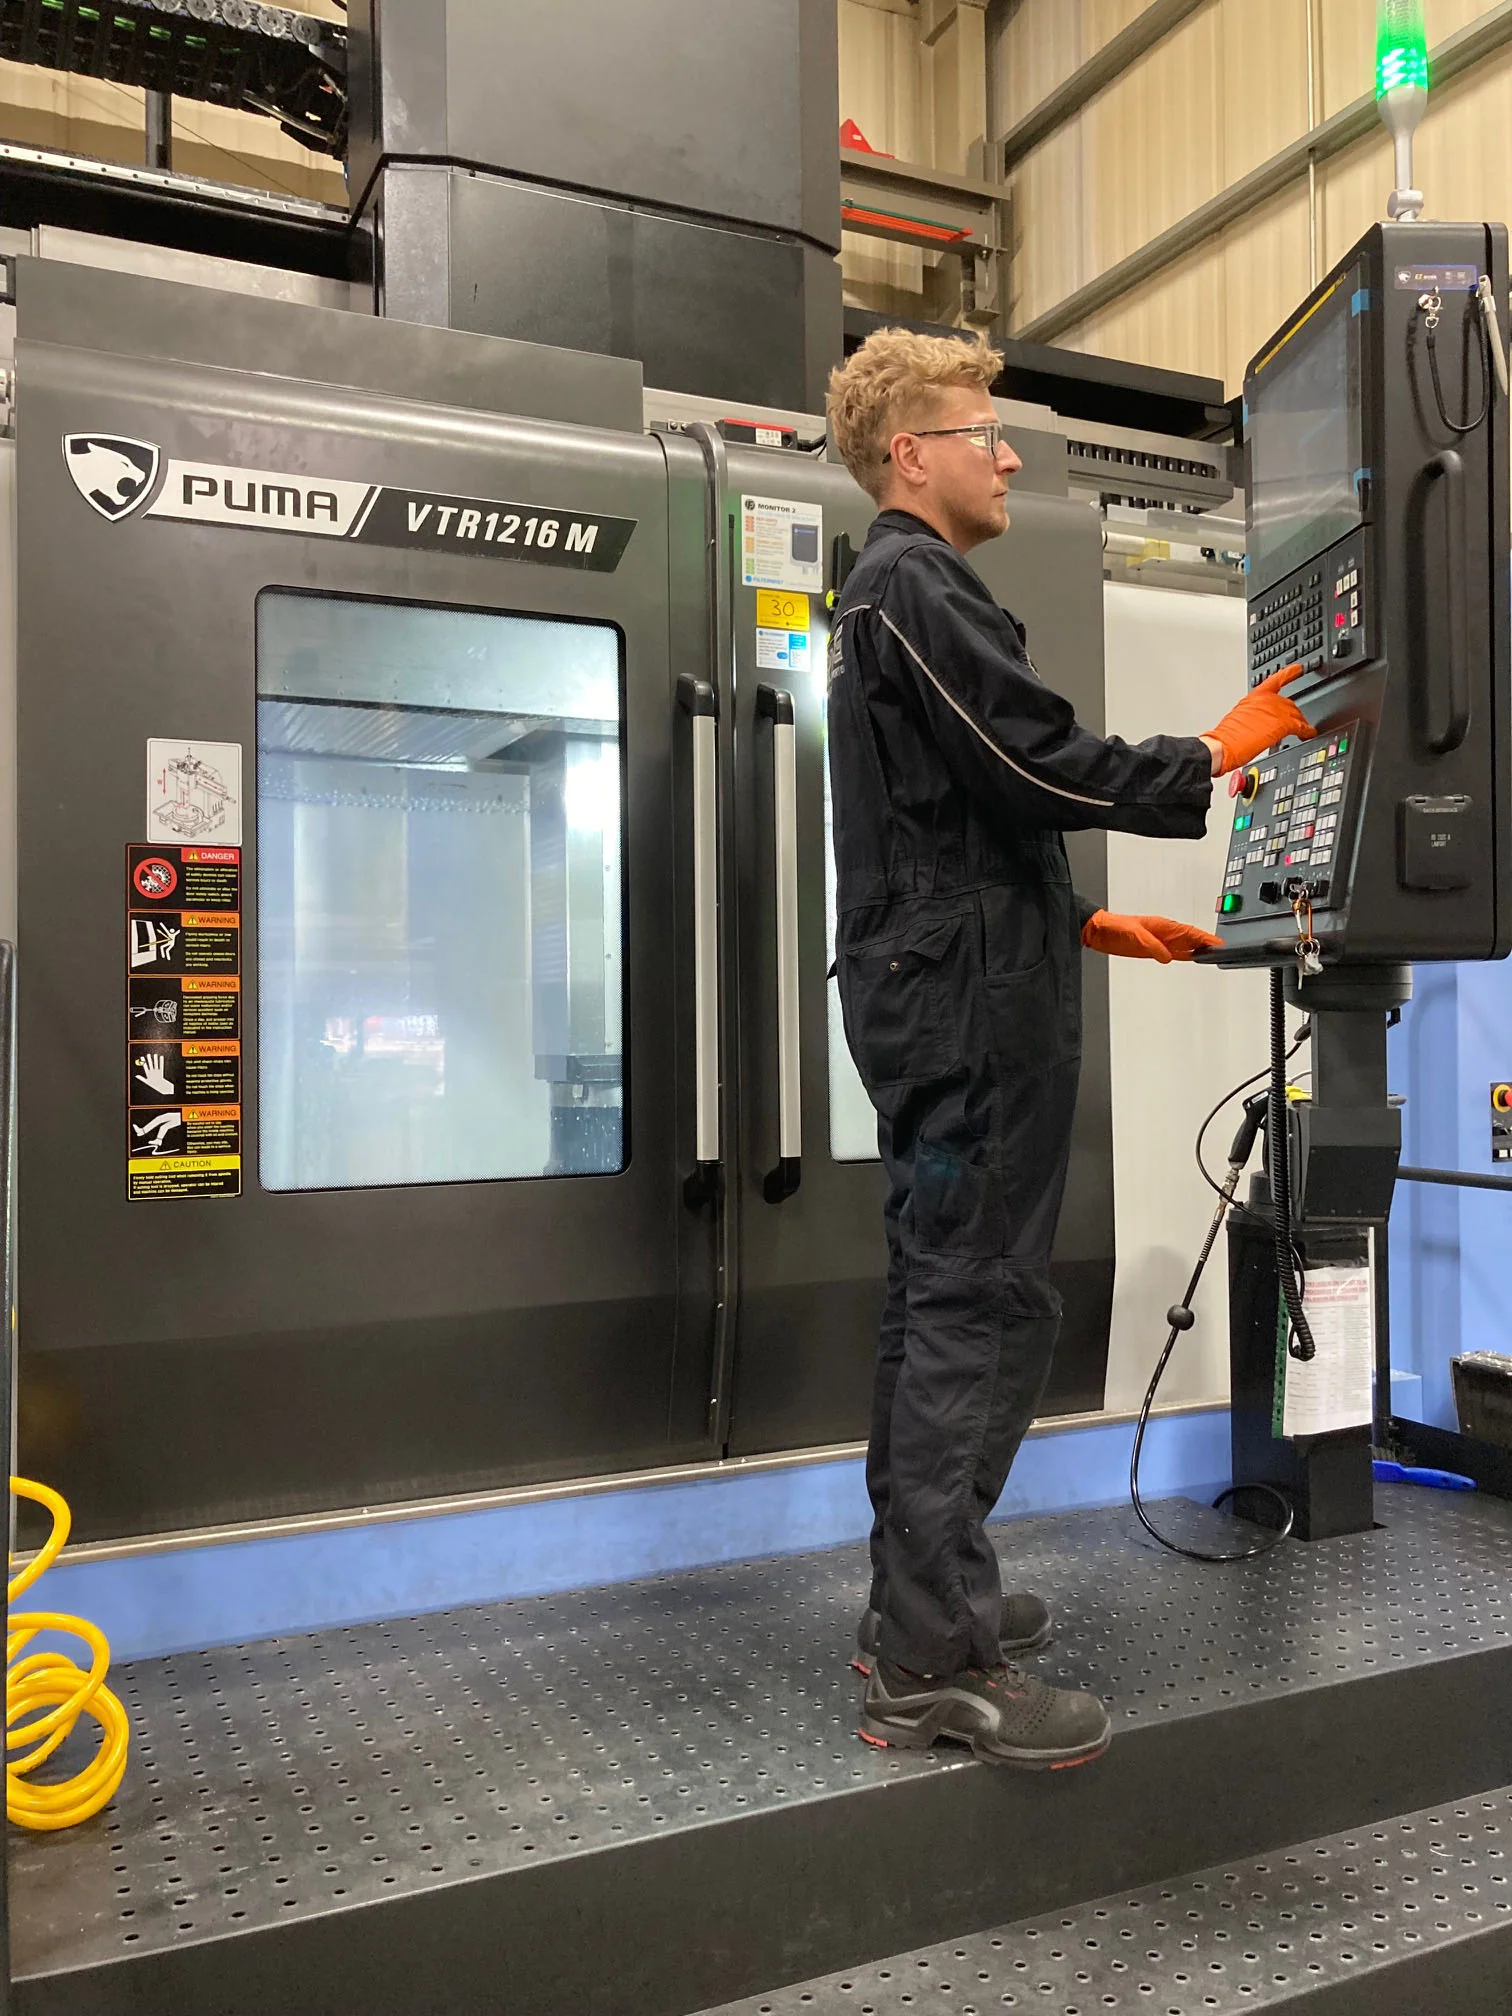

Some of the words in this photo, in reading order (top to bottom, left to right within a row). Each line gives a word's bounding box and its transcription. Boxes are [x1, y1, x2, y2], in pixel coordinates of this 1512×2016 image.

[183, 475, 338, 522] PUMA
[757, 503, 790, 513] MONITOR
[407, 502, 558, 547] VTR1216
[565, 524, 599, 554] M
[771, 599, 795, 616] 30
[201, 852, 235, 861] DANGER
[199, 1109, 238, 1117] WARNING
[173, 1160, 211, 1168] CAUTION
